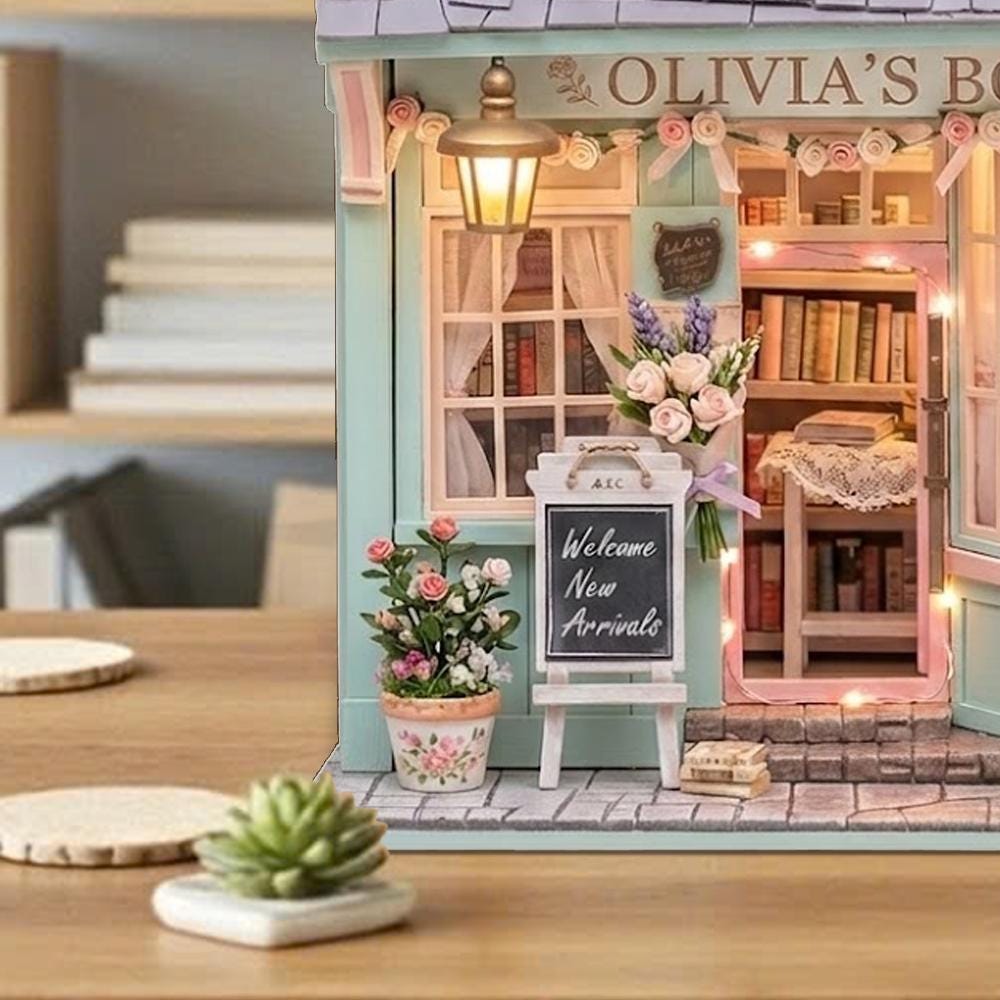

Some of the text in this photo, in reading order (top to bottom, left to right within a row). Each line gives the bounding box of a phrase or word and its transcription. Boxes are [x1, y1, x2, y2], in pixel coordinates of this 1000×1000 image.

[607, 53, 919, 106] OLIVIA'S
[564, 566, 617, 599] New
[561, 606, 662, 638] Arrivals
